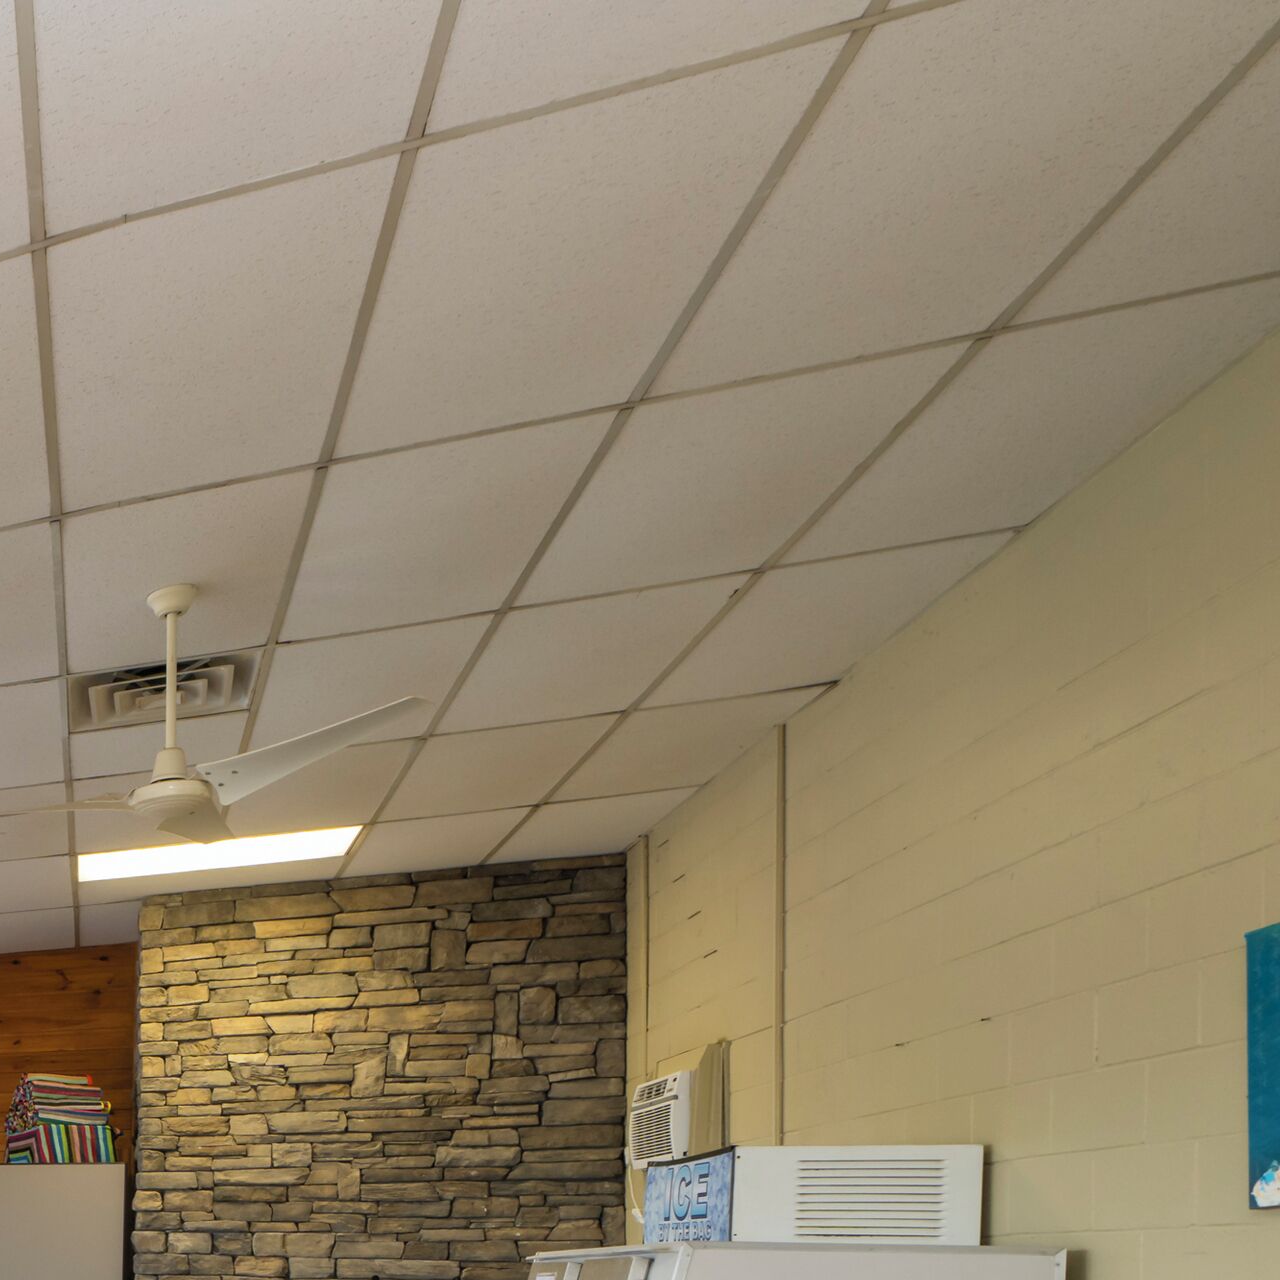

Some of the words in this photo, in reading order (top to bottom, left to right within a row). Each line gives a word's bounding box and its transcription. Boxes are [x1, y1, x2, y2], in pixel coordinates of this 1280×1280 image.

[663, 1162, 710, 1221] ICE
[657, 1223, 670, 1242] BY
[671, 1221, 691, 1241] THE
[692, 1220, 712, 1241] BAG
